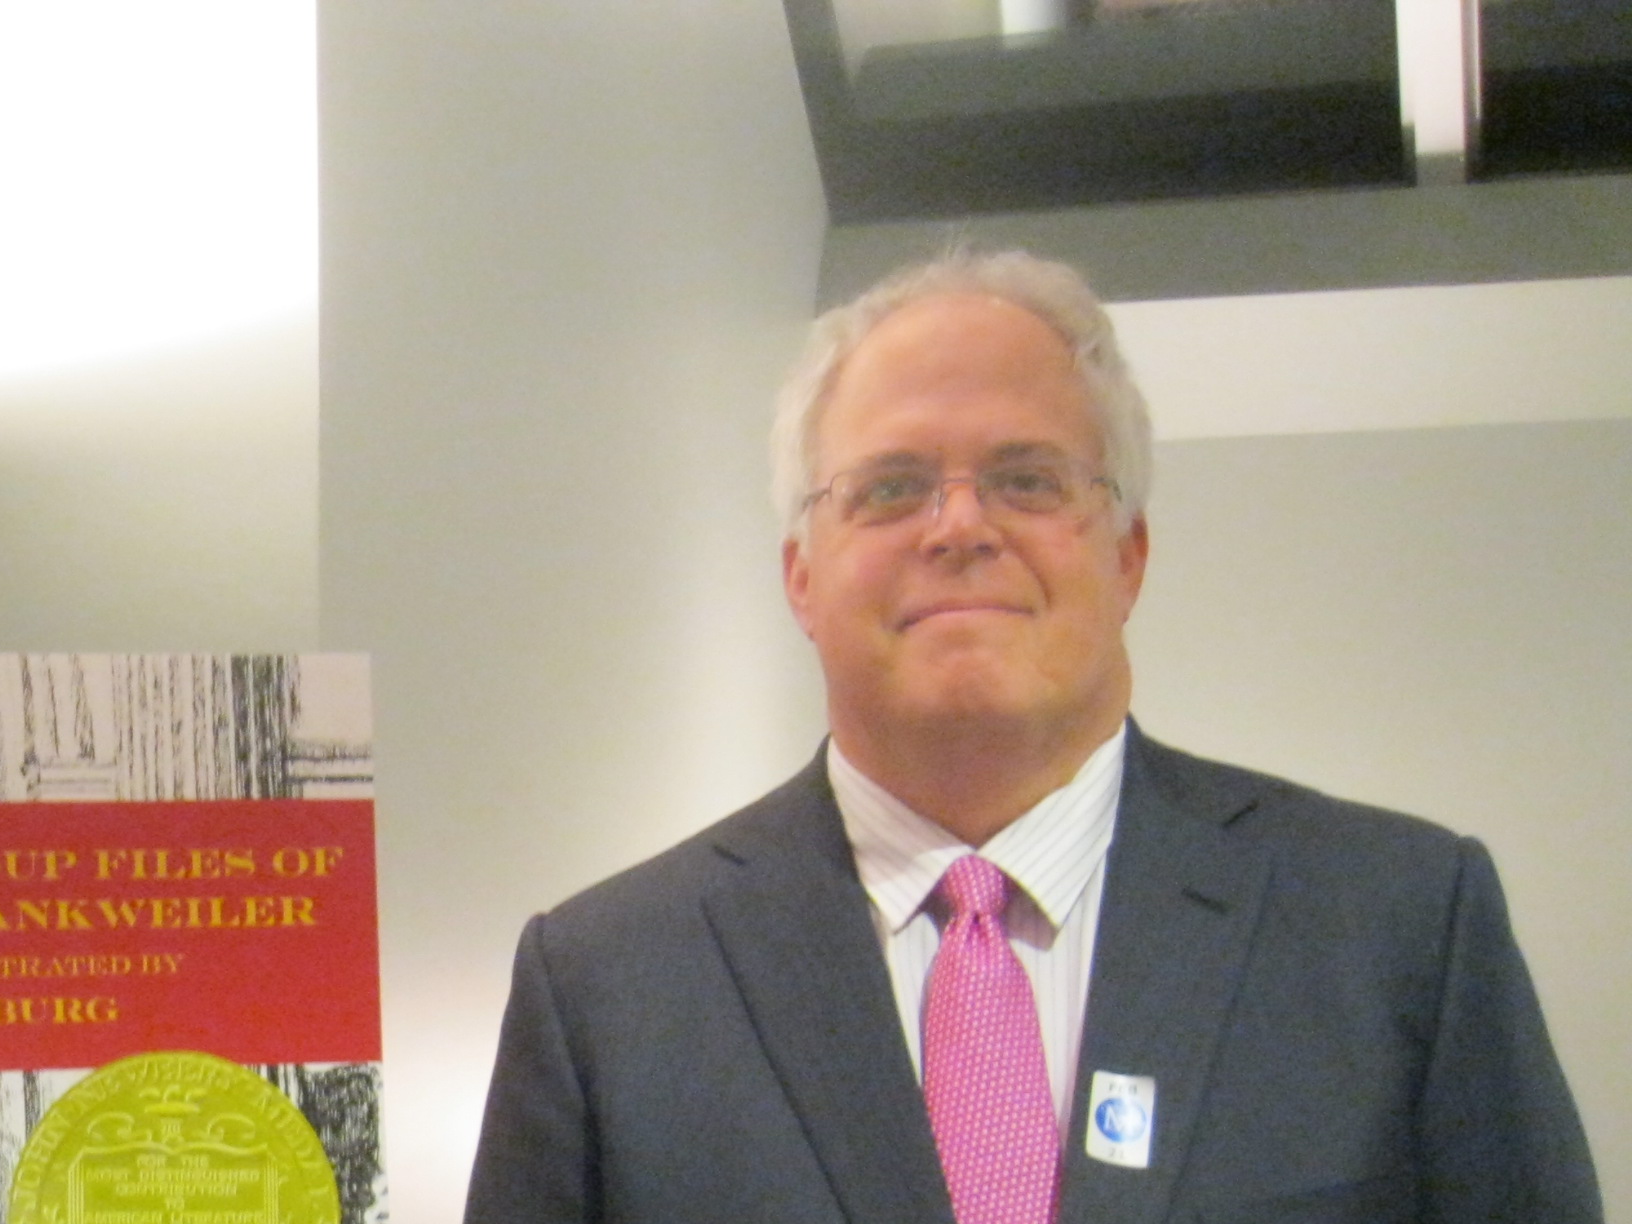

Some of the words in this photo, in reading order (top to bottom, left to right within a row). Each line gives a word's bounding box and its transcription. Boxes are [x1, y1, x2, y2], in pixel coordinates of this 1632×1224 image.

[94, 847, 258, 881] FILES
[271, 846, 345, 879] OF
[141, 953, 184, 976] BY
